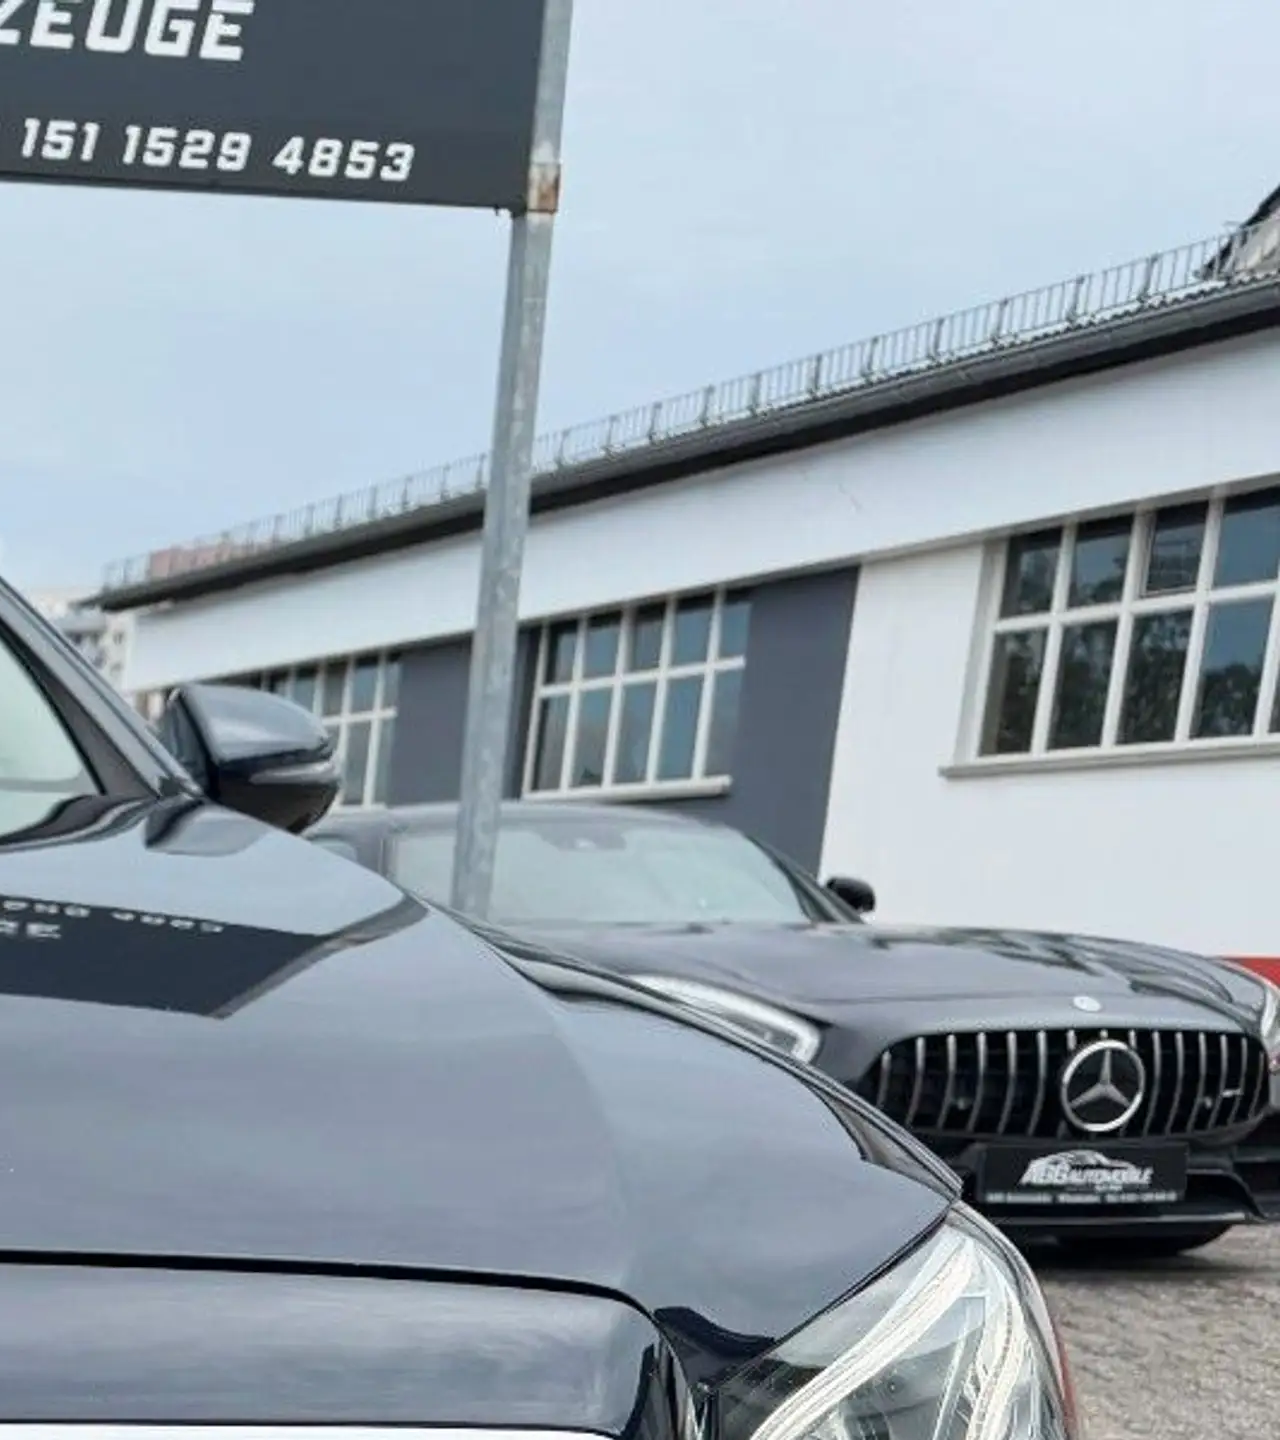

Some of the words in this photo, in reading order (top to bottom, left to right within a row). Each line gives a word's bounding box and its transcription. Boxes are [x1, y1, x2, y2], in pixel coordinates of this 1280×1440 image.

[22, 118, 100, 161] 151
[122, 125, 252, 172] 1529
[272, 136, 416, 182] 4853
